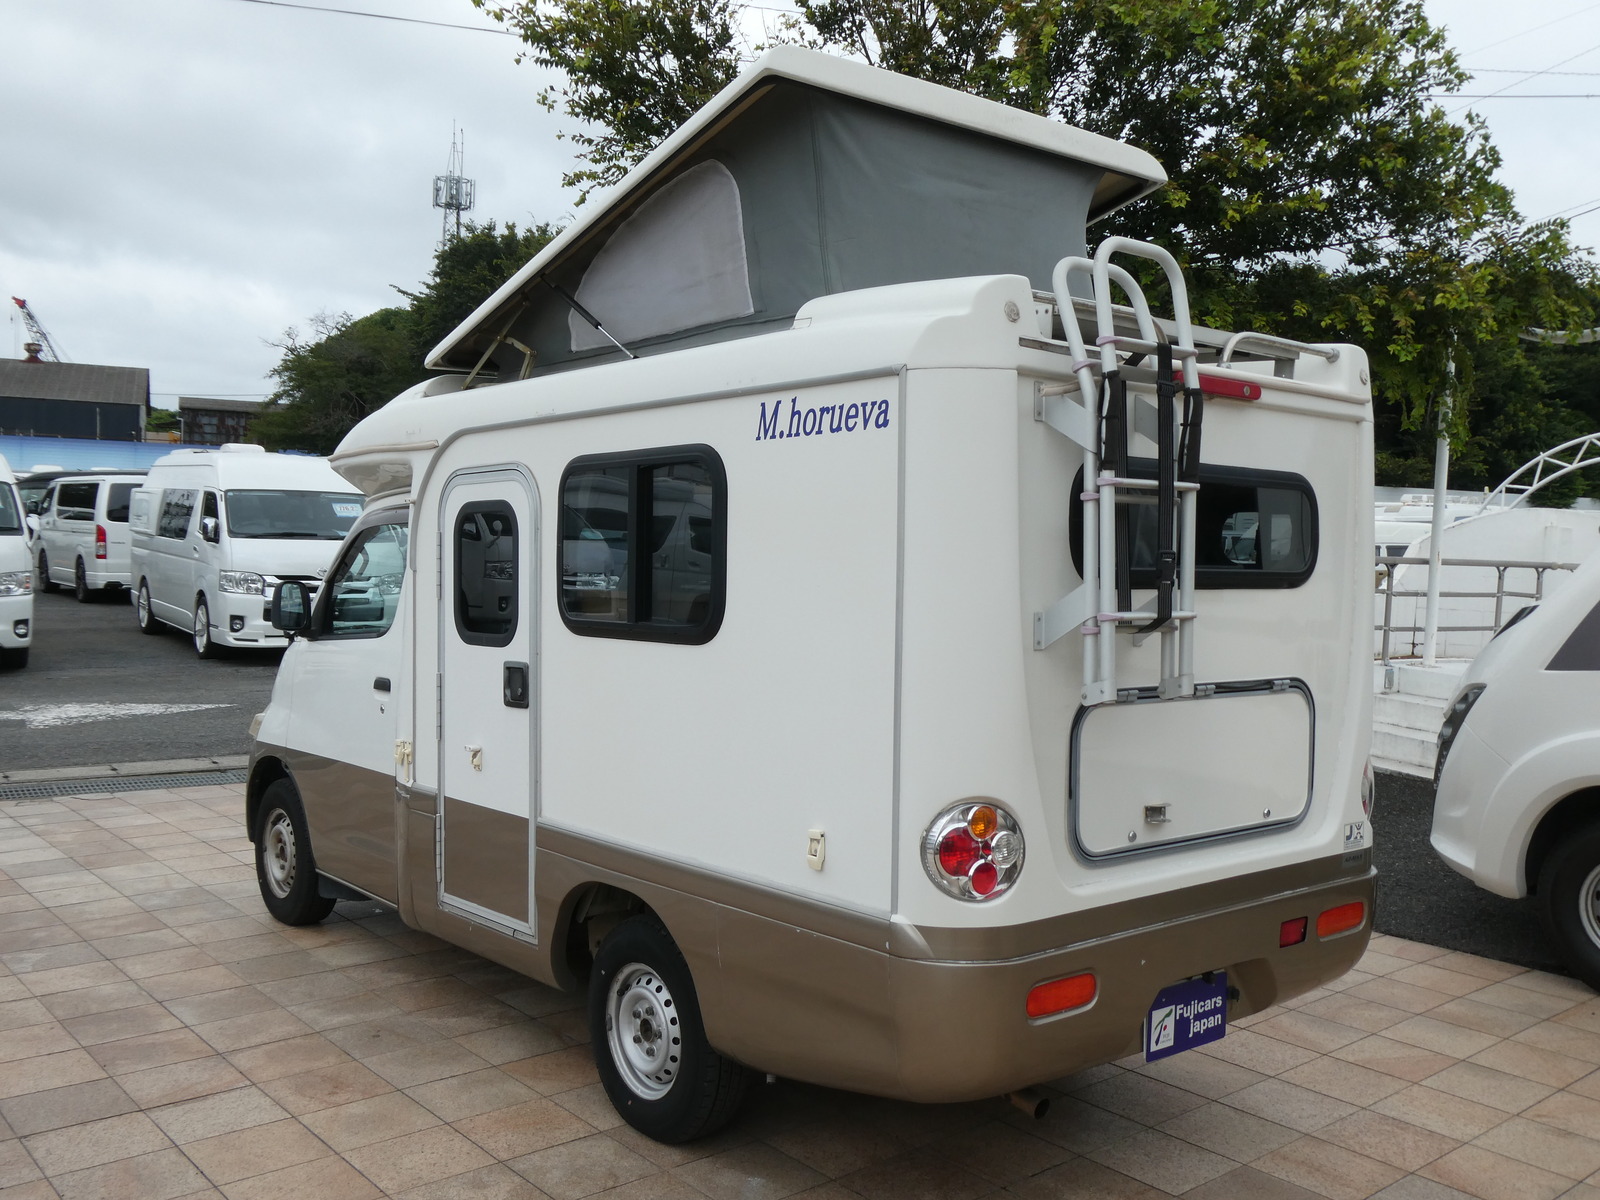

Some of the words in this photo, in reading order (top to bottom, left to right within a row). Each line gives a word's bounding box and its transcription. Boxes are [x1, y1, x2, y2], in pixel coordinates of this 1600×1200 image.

[755, 396, 890, 441] M.horueva
[1176, 996, 1222, 1020] Fujicars
[1188, 1013, 1222, 1038] japan
